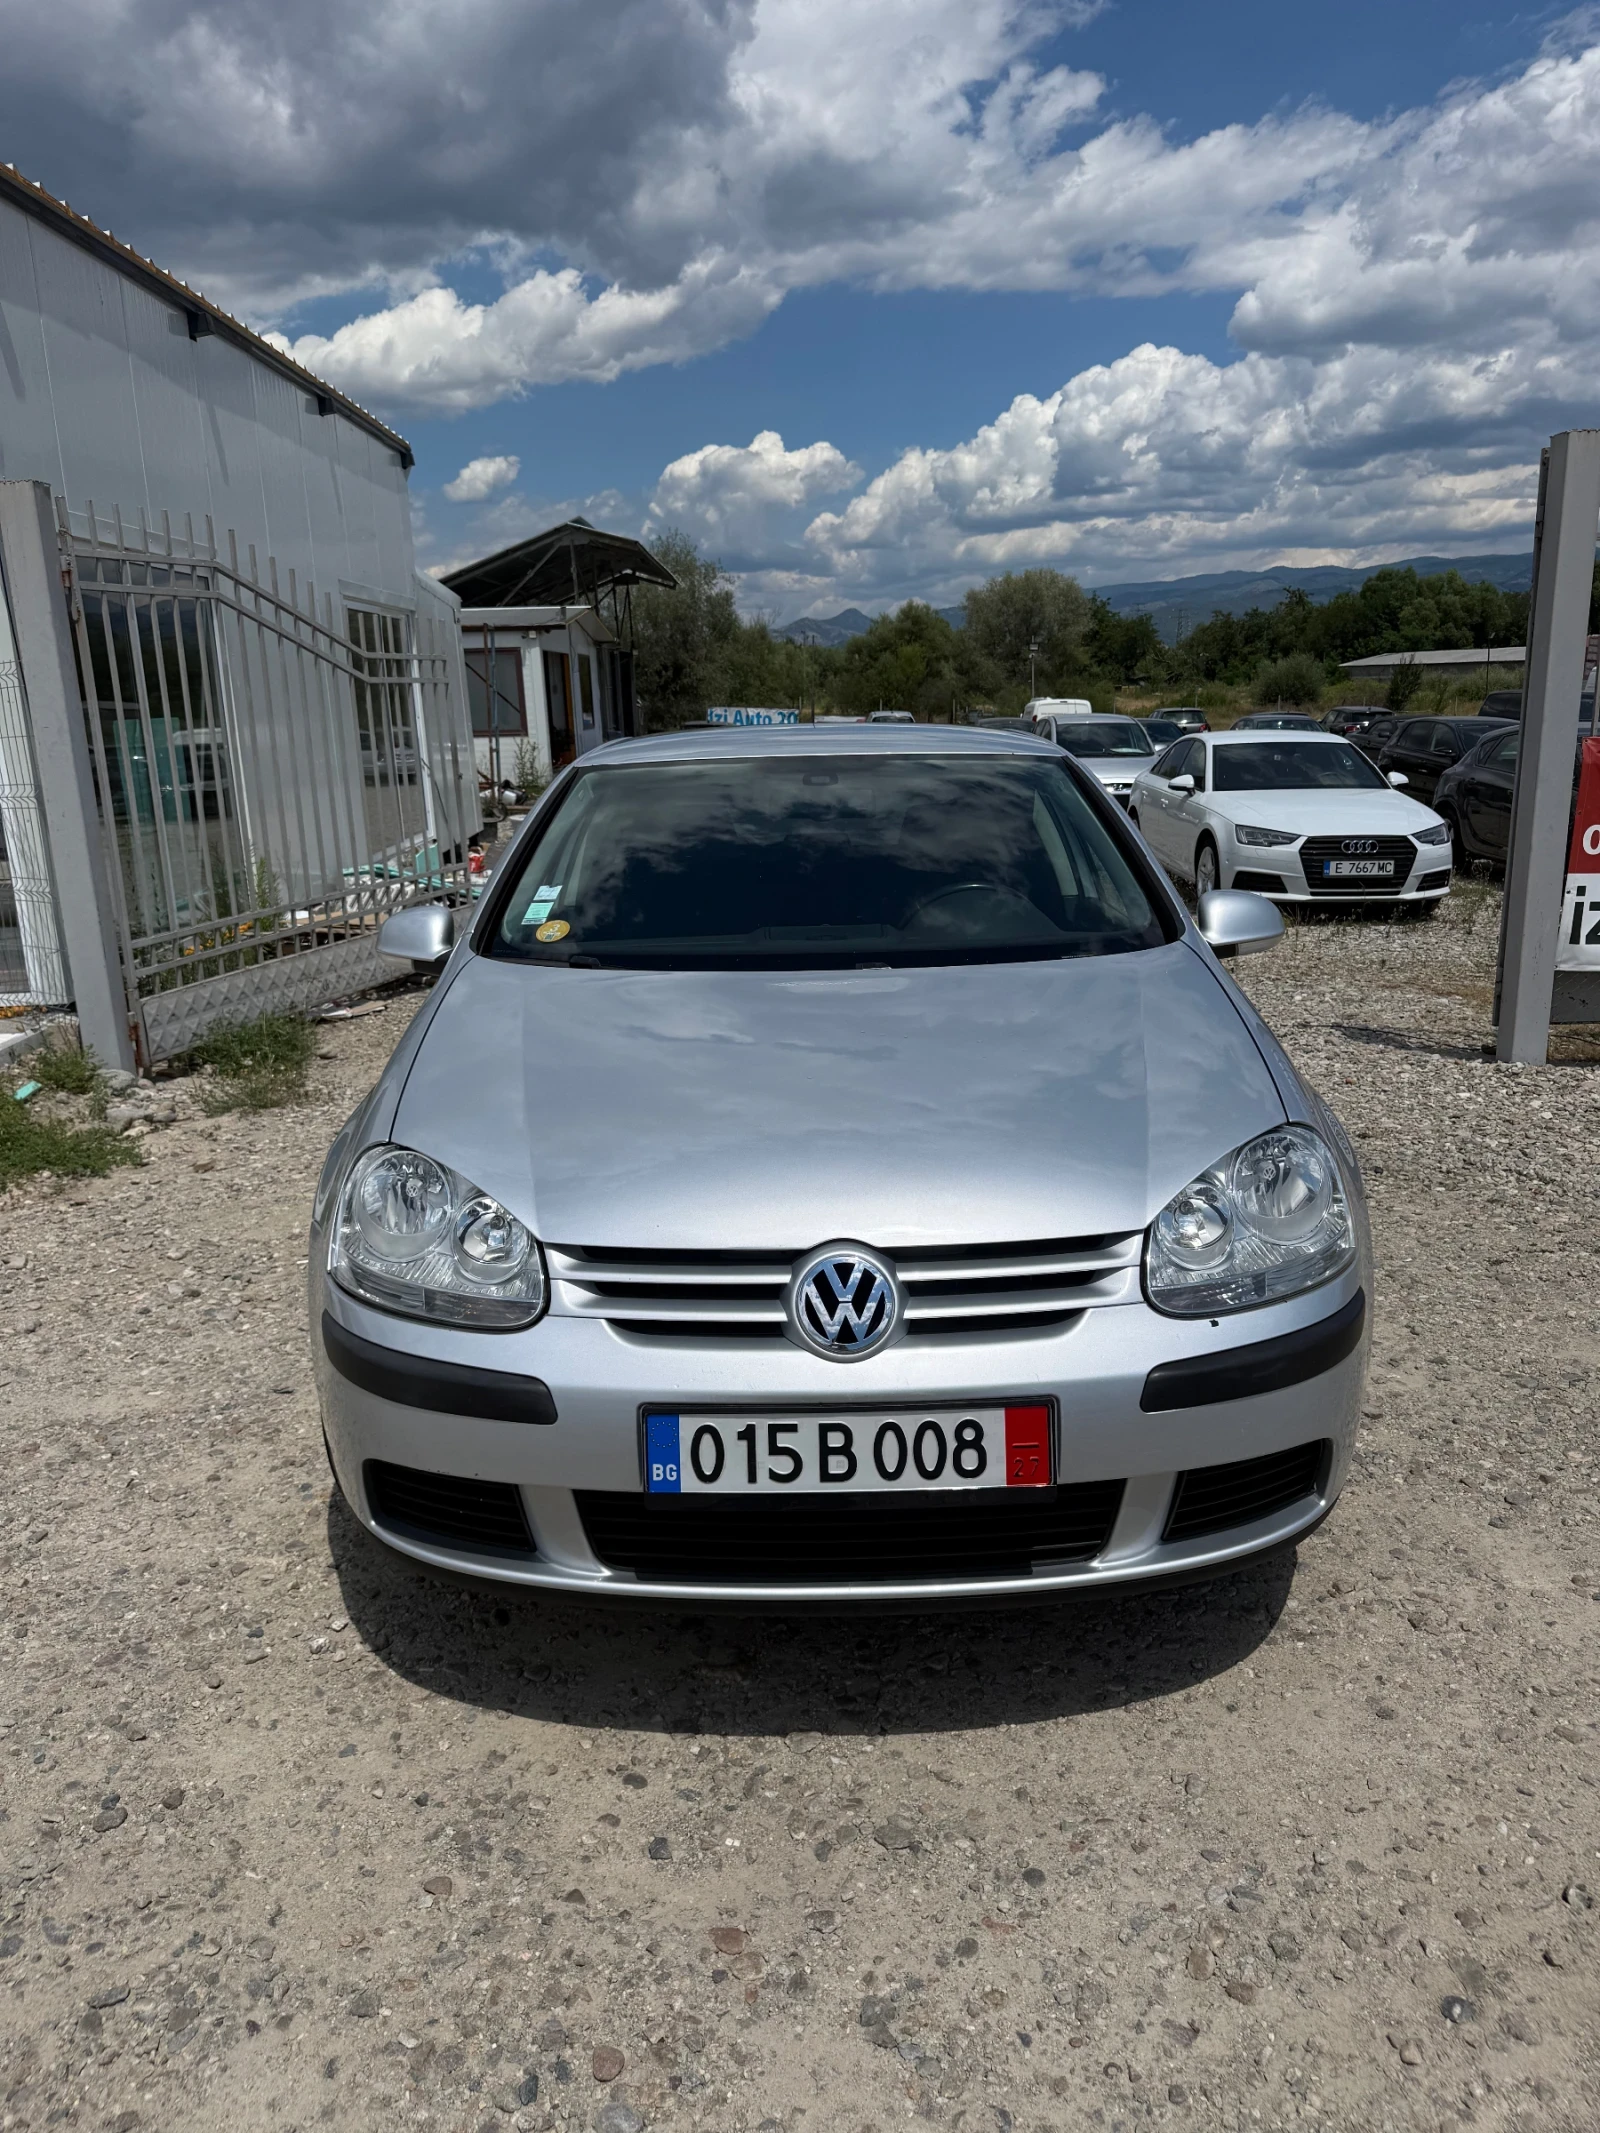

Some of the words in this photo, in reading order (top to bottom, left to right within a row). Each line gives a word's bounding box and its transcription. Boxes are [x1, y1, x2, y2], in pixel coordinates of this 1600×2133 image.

[734, 710, 772, 725] Auto
[1335, 862, 1343, 874] E
[1348, 862, 1376, 874] 7667
[1377, 862, 1392, 873] MC
[652, 1463, 677, 1481] BG
[1013, 1456, 1040, 1477] 27
